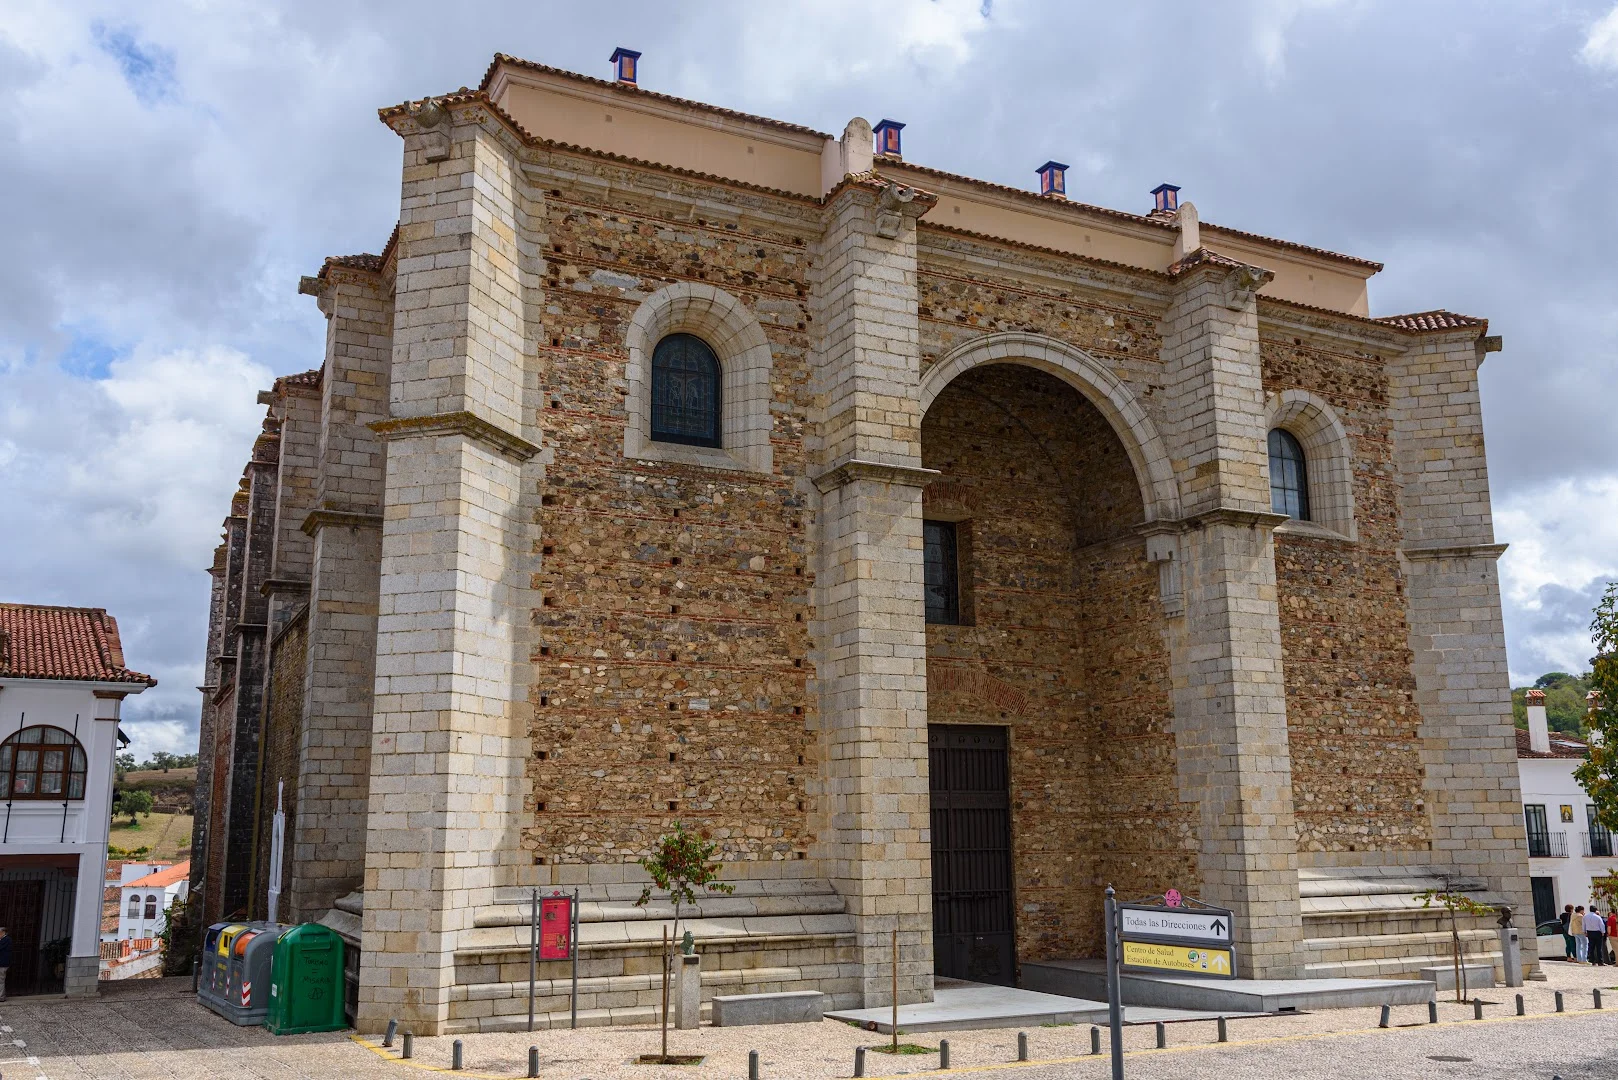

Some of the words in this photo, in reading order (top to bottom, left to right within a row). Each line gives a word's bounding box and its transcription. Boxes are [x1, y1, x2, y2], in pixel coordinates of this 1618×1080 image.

[1125, 916, 1147, 927] Todas
[1149, 918, 1160, 927] las
[1161, 919, 1207, 931] Direcciones
[1126, 945, 1147, 954] Centro
[1148, 947, 1155, 955] de
[1156, 948, 1174, 957] Salud
[1126, 955, 1152, 965] Estación
[1153, 957, 1161, 965] de
[1162, 959, 1195, 969] Autobuses
